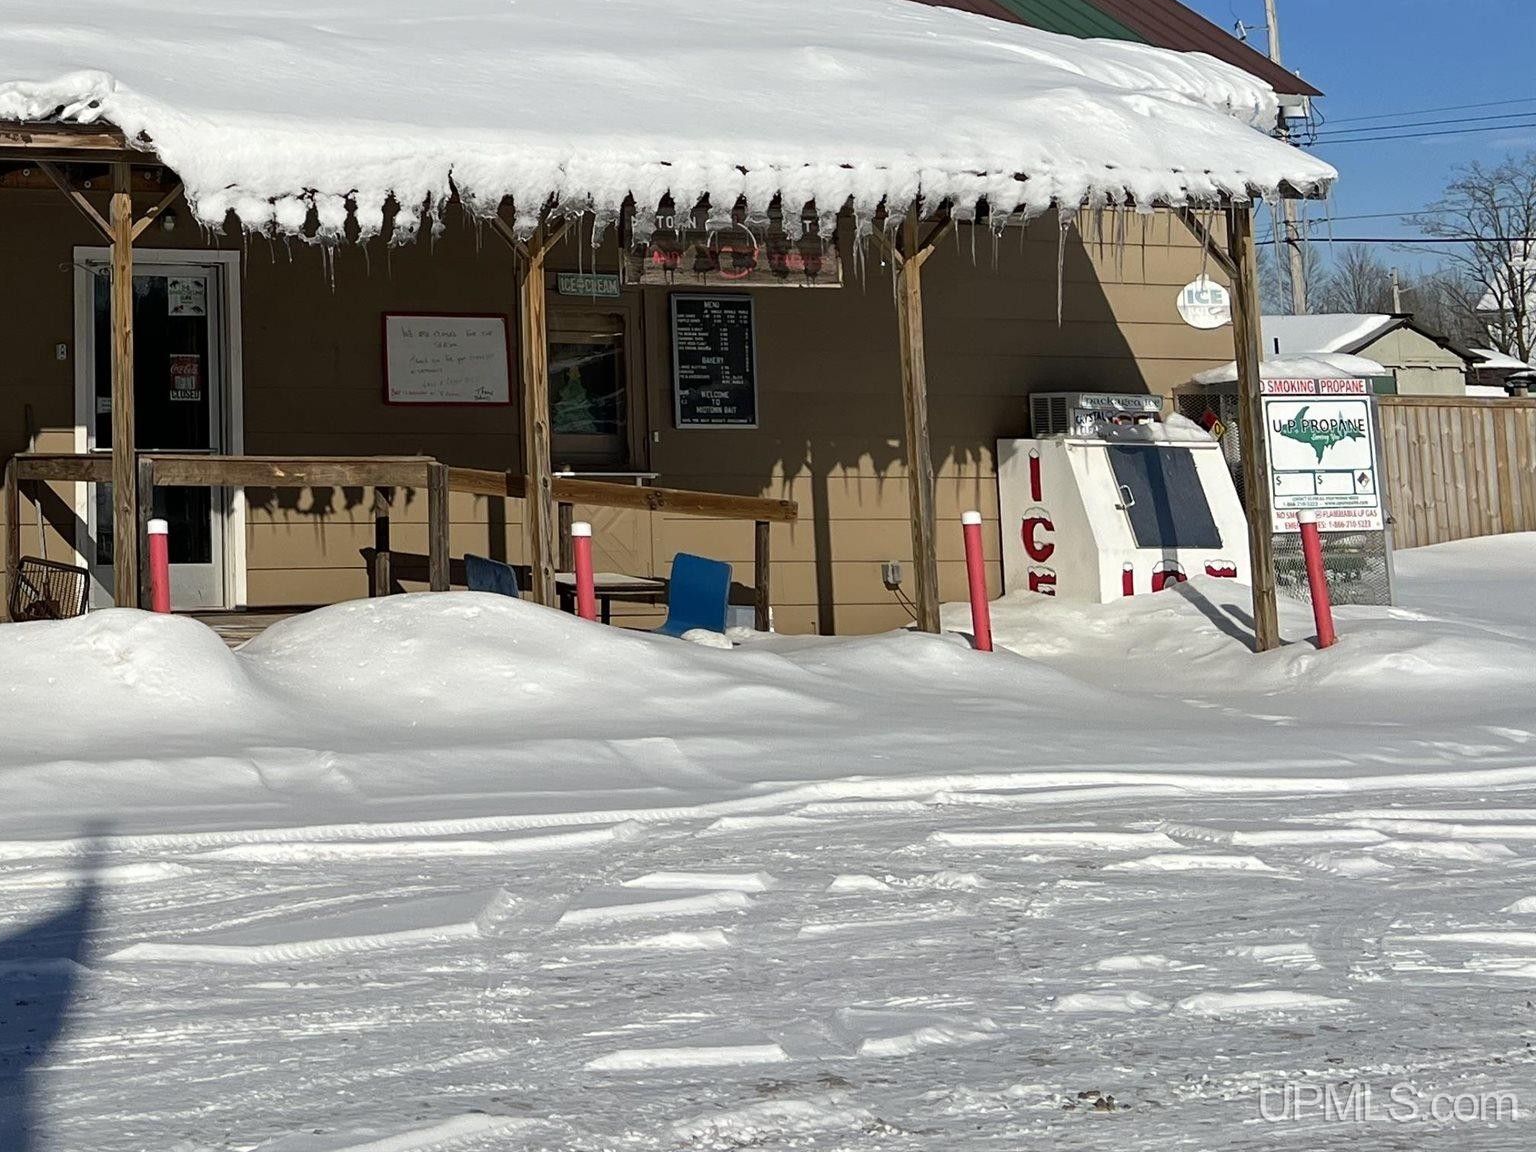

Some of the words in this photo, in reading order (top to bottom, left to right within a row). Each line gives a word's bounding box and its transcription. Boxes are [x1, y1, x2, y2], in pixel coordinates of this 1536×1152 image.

[560, 277, 577, 292] ICE
[1187, 289, 1223, 304] ICE
[1267, 380, 1314, 393] SMOKING
[1320, 380, 1364, 393] PROPANE
[1301, 418, 1366, 434] PROPANE
[1365, 509, 1378, 518] GAS
